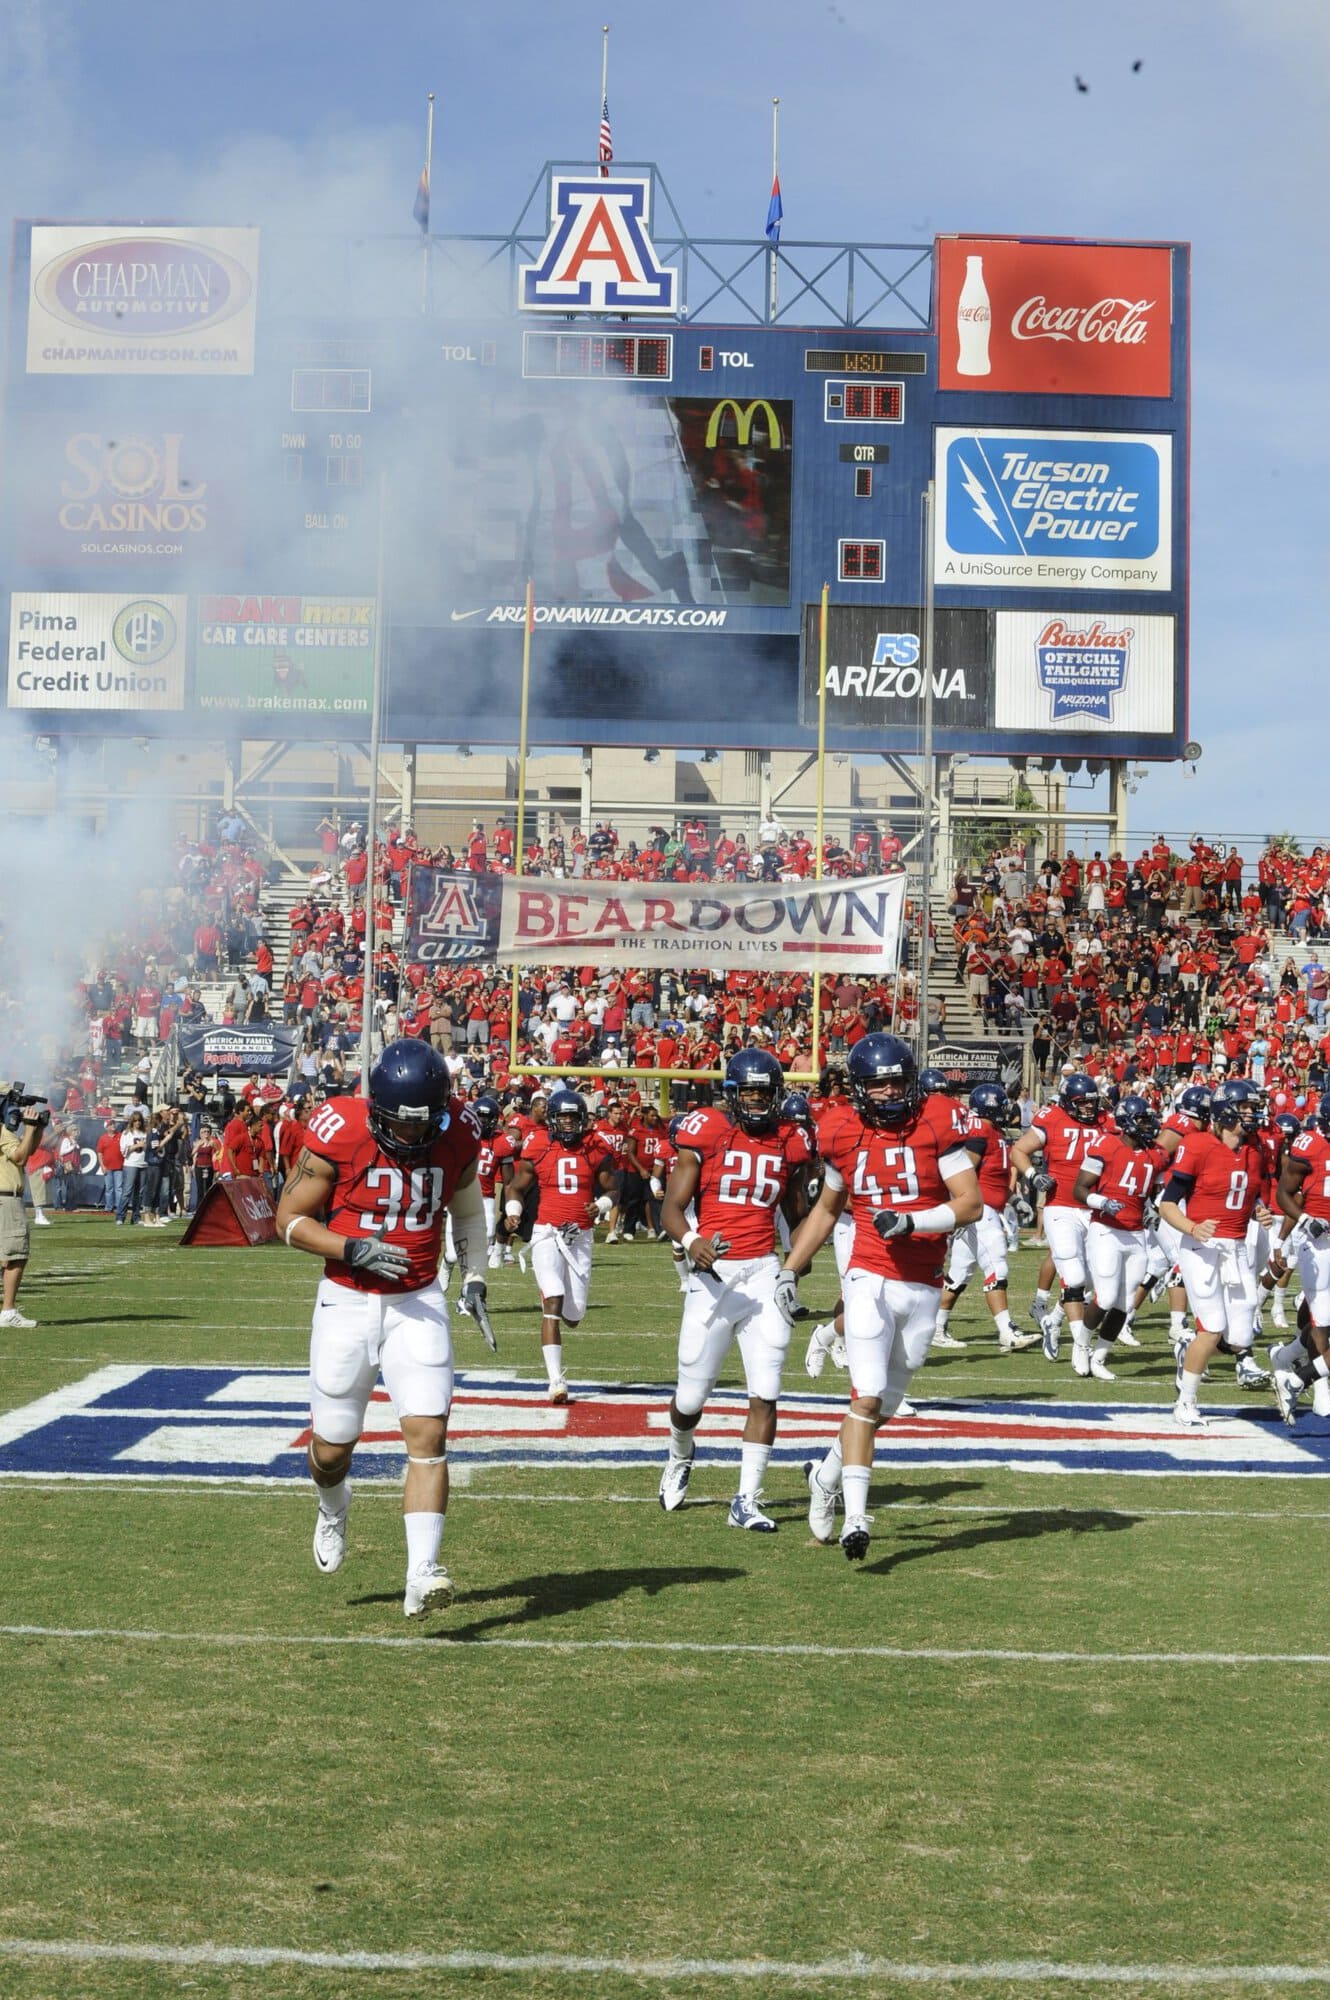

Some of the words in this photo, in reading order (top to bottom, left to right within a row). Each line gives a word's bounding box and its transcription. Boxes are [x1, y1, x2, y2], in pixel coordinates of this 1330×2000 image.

[518, 176, 678, 312] A
[72, 262, 214, 299] CHAPMAN
[76, 300, 209, 314] AUTOMOTIVE
[1011, 295, 1156, 344] Coca-Cola
[42, 347, 239, 362] CHAPMANTUCSON.COM
[440, 345, 477, 361] TOL
[719, 351, 754, 368] TOL
[845, 354, 884, 372] WSU
[329, 434, 343, 448] TO
[346, 434, 362, 448] GO
[854, 446, 875, 461] QTR
[1001, 453, 1110, 484] Tucson
[1012, 482, 1139, 512] Electric
[59, 504, 208, 532] CASINOS
[304, 513, 329, 528] BALL
[1024, 511, 1138, 541] Power
[81, 543, 183, 554] SOLCASINOS.COM
[944, 561, 955, 574] A
[960, 562, 1033, 577] UniSource
[1038, 564, 1087, 580] Energy
[1091, 565, 1158, 583] Company
[19, 611, 77, 631] Pima
[202, 627, 237, 645] CAR
[243, 627, 288, 646] CARE
[295, 627, 369, 647] CENTERS
[1039, 622, 1131, 648] Bashas'
[18, 641, 106, 661] Federal
[872, 632, 921, 667] FS
[1044, 652, 1120, 665] OFFICIAL
[16, 671, 90, 692] Credit
[96, 672, 167, 692] Union
[1044, 665, 1120, 677] TAILGATE
[1045, 677, 1119, 686] HEADQUARTERS
[816, 665, 967, 700] ARIZONA
[1057, 694, 1107, 704] ARIZONA
[419, 874, 487, 940] A
[417, 942, 486, 961] CLUB
[621, 938, 647, 949] THE
[653, 938, 733, 951] TRADITION
[738, 940, 778, 952] LIVES
[204, 1037, 244, 1045] AMERICAN
[308, 1103, 346, 1144] 38
[678, 1110, 709, 1136] 26
[1063, 1128, 1100, 1160] 72
[557, 1157, 579, 1195] 6
[718, 1150, 783, 1208] 26
[853, 1146, 920, 1206] 43
[1118, 1161, 1154, 1198] 41
[359, 1167, 445, 1232] 38
[1225, 1170, 1249, 1210] 8
